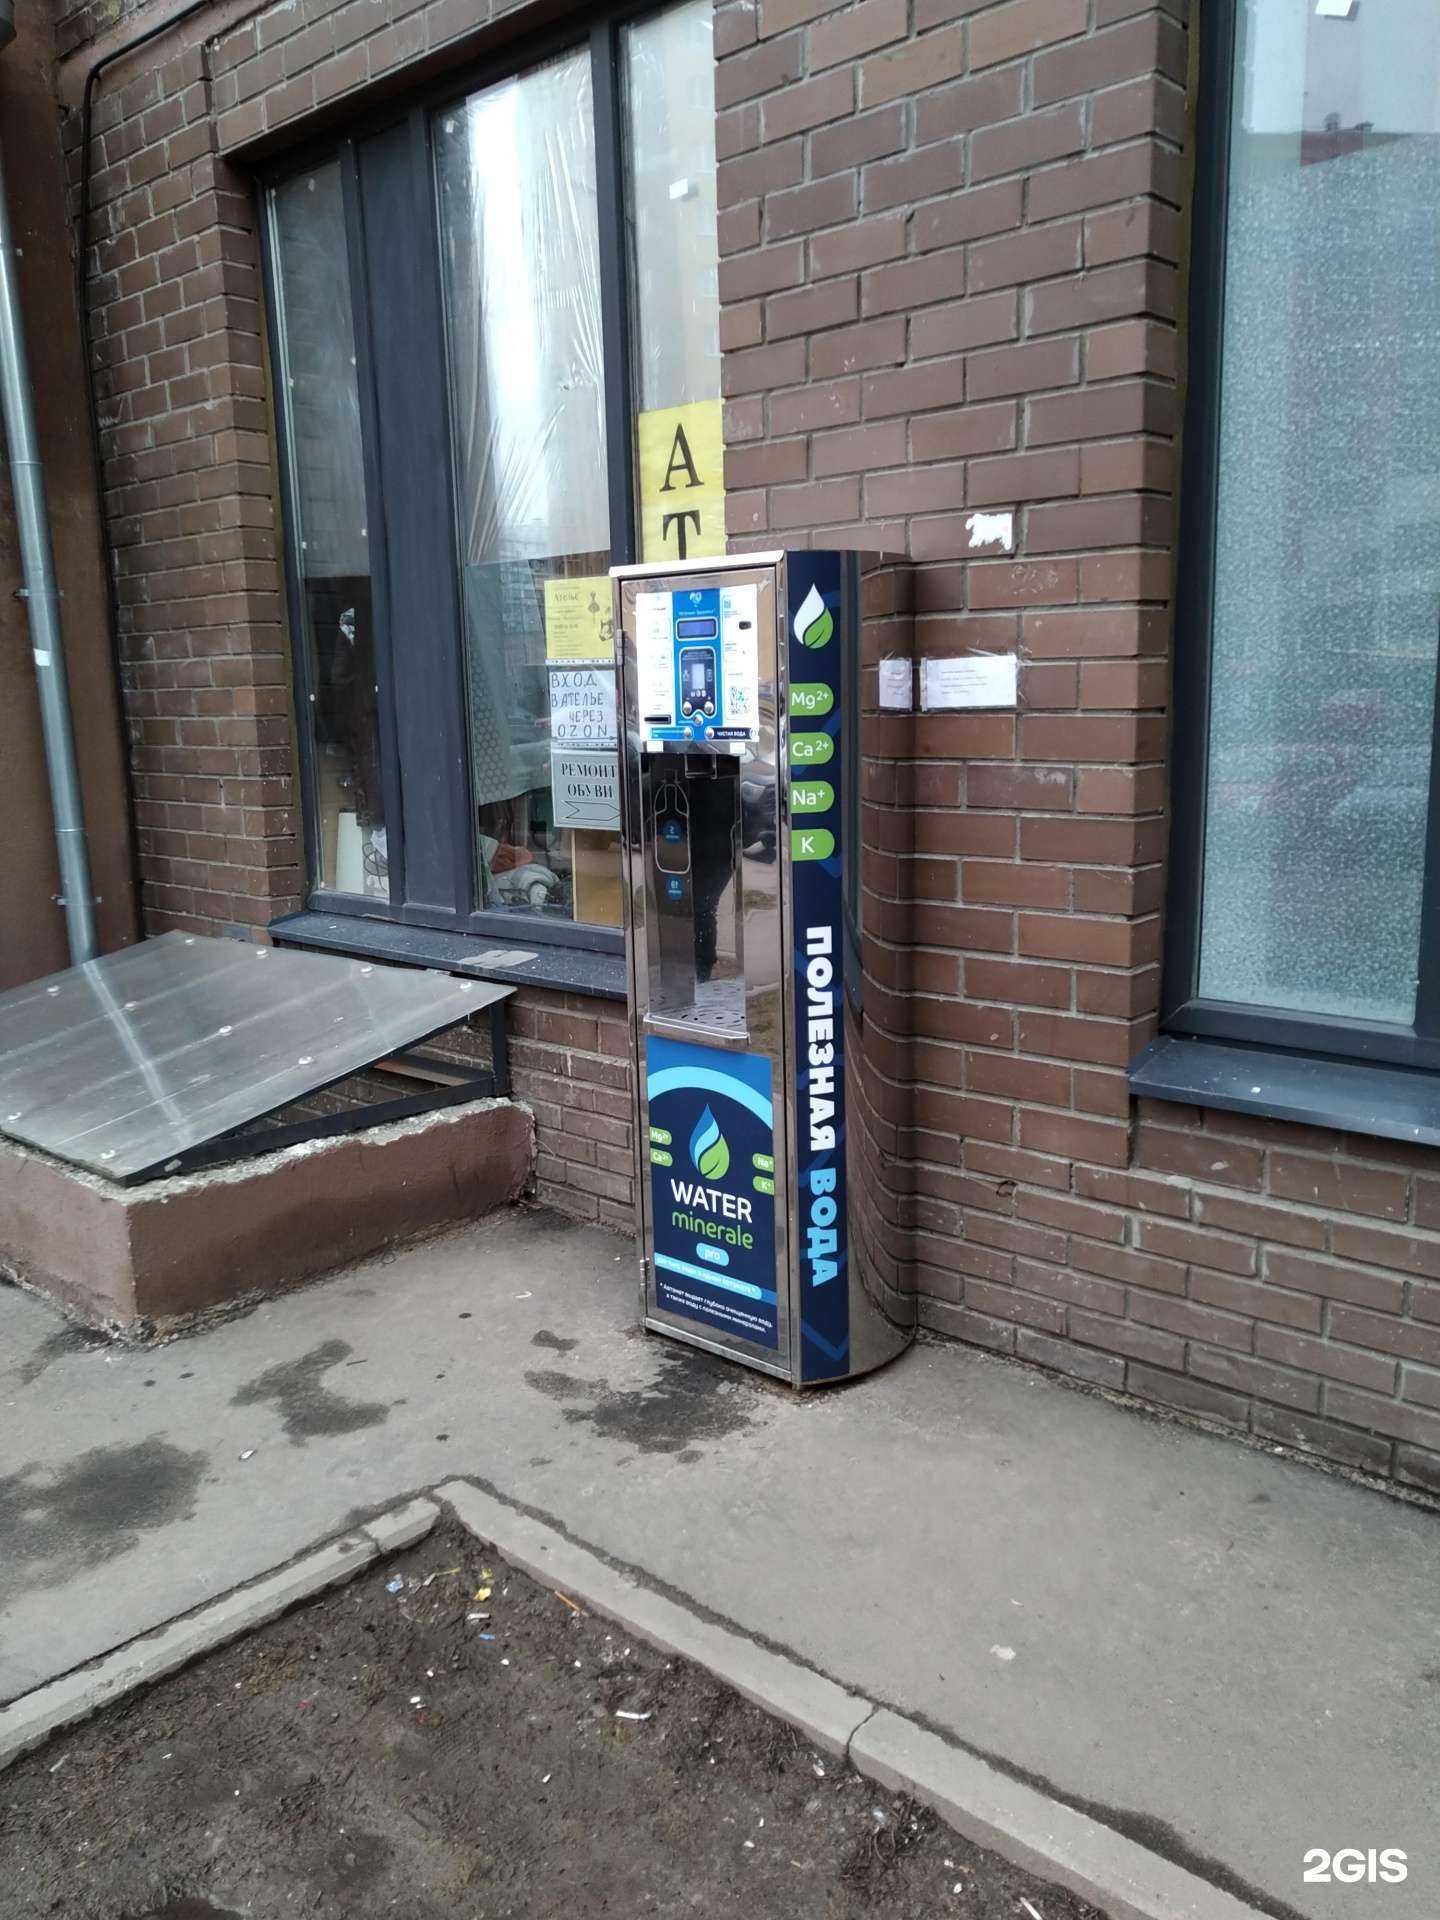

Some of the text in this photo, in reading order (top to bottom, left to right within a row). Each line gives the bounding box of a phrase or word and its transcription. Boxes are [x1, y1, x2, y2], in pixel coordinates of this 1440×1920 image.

[551, 672, 598, 688] ВХОД
[568, 710, 604, 723] ЧЕРЕЗ
[557, 723, 608, 738] OZON
[561, 763, 617, 778] РЕМОНТ
[567, 783, 614, 799] ОБУВИ
[792, 789, 826, 806] Na+
[801, 836, 816, 853] K
[806, 925, 838, 1288] ПОЛЕЗНАЯ ВОДА
[670, 1178, 753, 1223] WATER
[672, 1210, 754, 1250] minerale
[704, 1249, 720, 1262] pro
